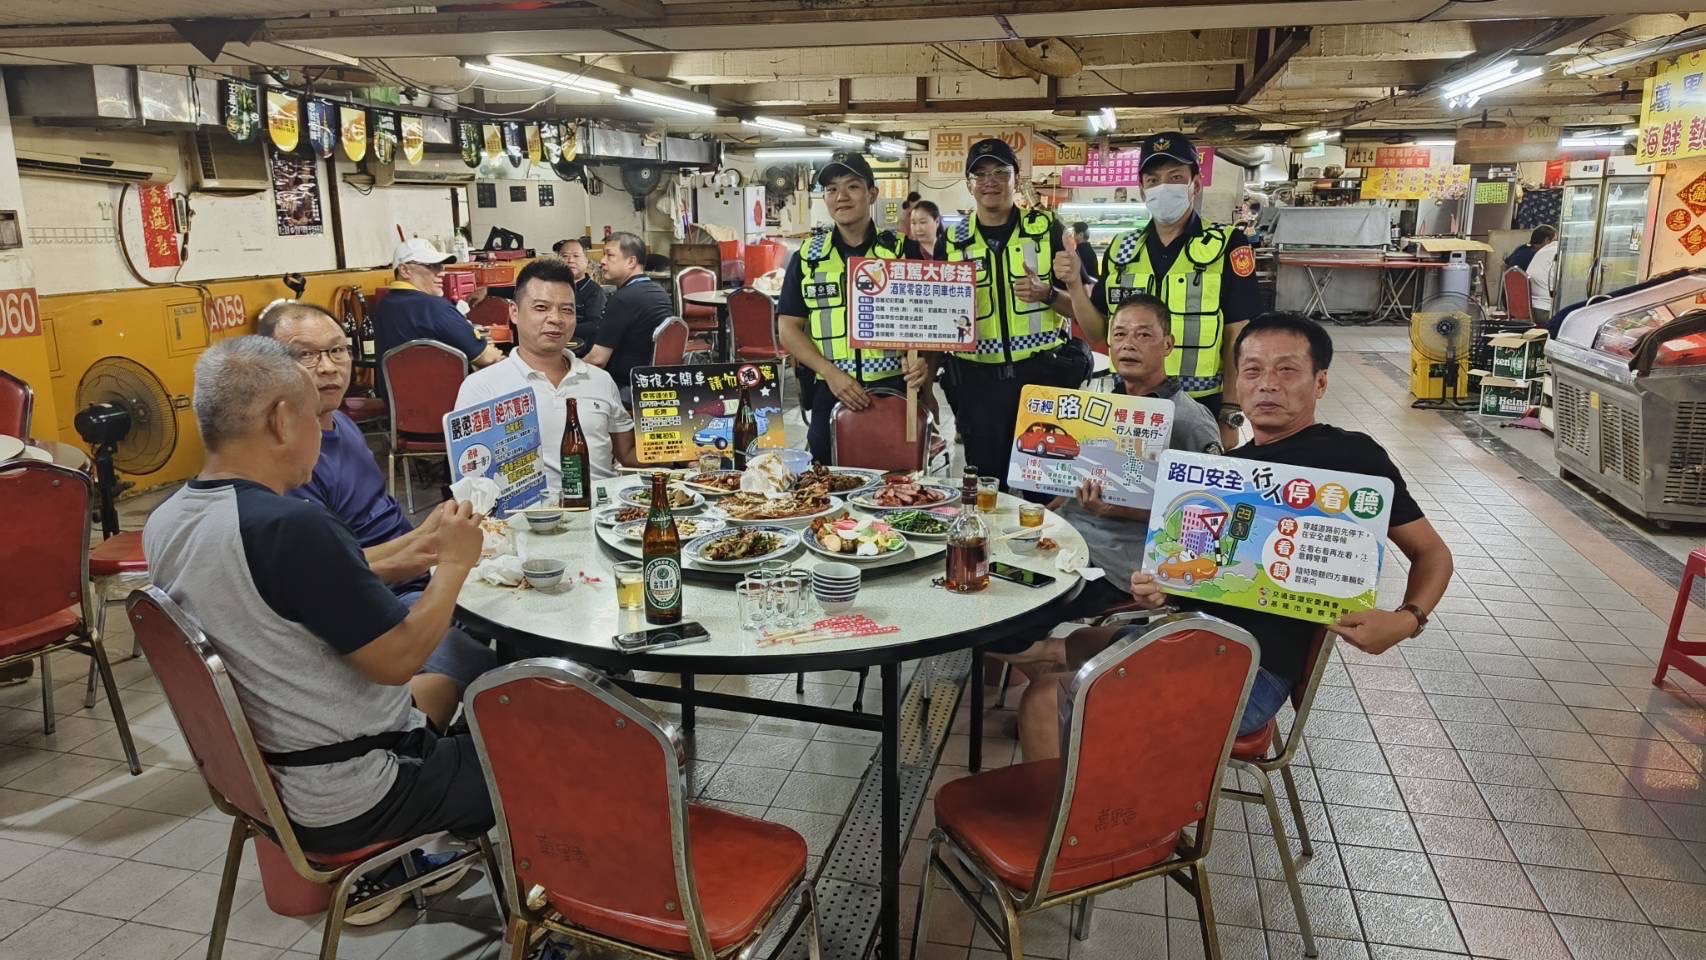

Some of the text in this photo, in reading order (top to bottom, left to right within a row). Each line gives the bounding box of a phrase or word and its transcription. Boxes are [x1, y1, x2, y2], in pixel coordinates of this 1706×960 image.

[890, 261, 972, 282] 酒駕大修法
[890, 282, 972, 298] 酒駕零容忍 同車也共責
[209, 294, 245, 330] A059
[635, 371, 706, 388] 酒後不開車
[1027, 394, 1165, 428] 行經 路口 慢看停
[1167, 461, 1245, 491] 路口安全
[1252, 466, 1283, 506] 行人
